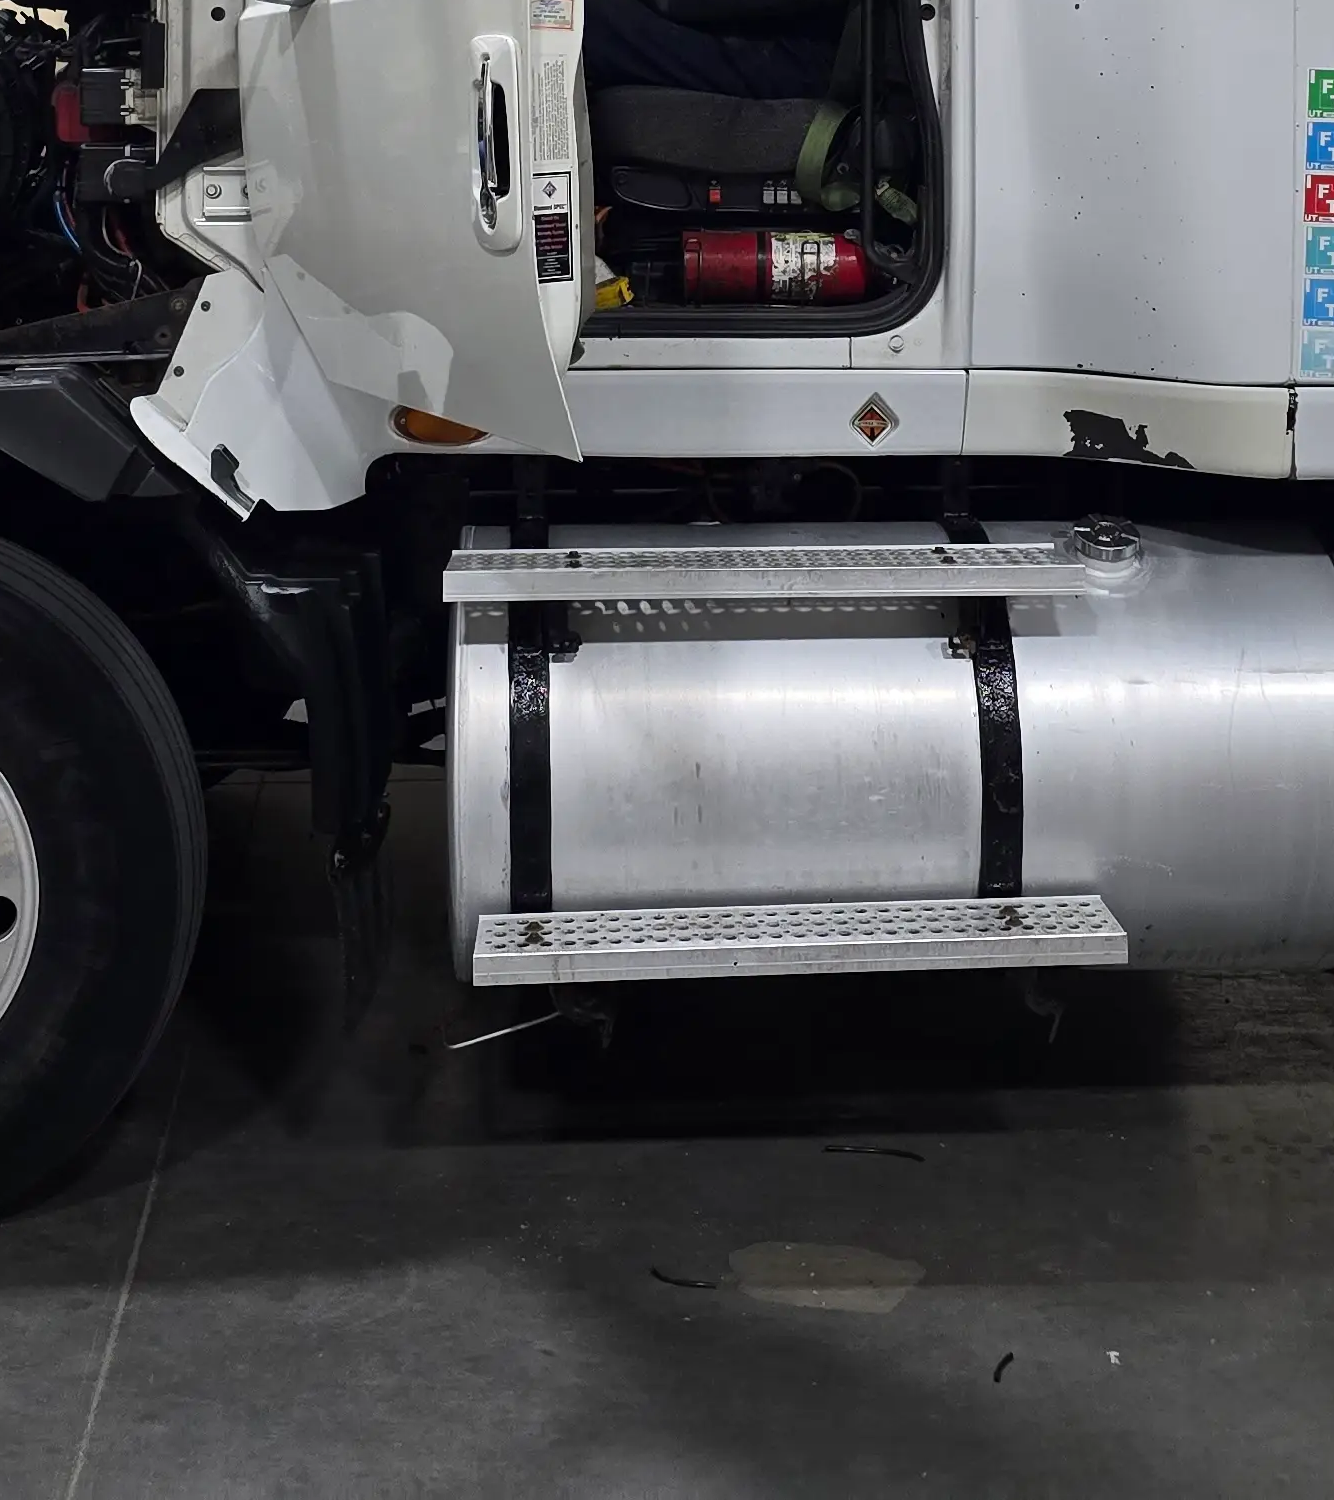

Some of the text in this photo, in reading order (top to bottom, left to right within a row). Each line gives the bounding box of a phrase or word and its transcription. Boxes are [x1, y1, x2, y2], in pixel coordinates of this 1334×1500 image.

[1308, 109, 1322, 118] UT
[1306, 162, 1321, 170] UT
[1304, 214, 1319, 222] UT
[1305, 266, 1320, 274] UT
[1303, 318, 1318, 326] UT
